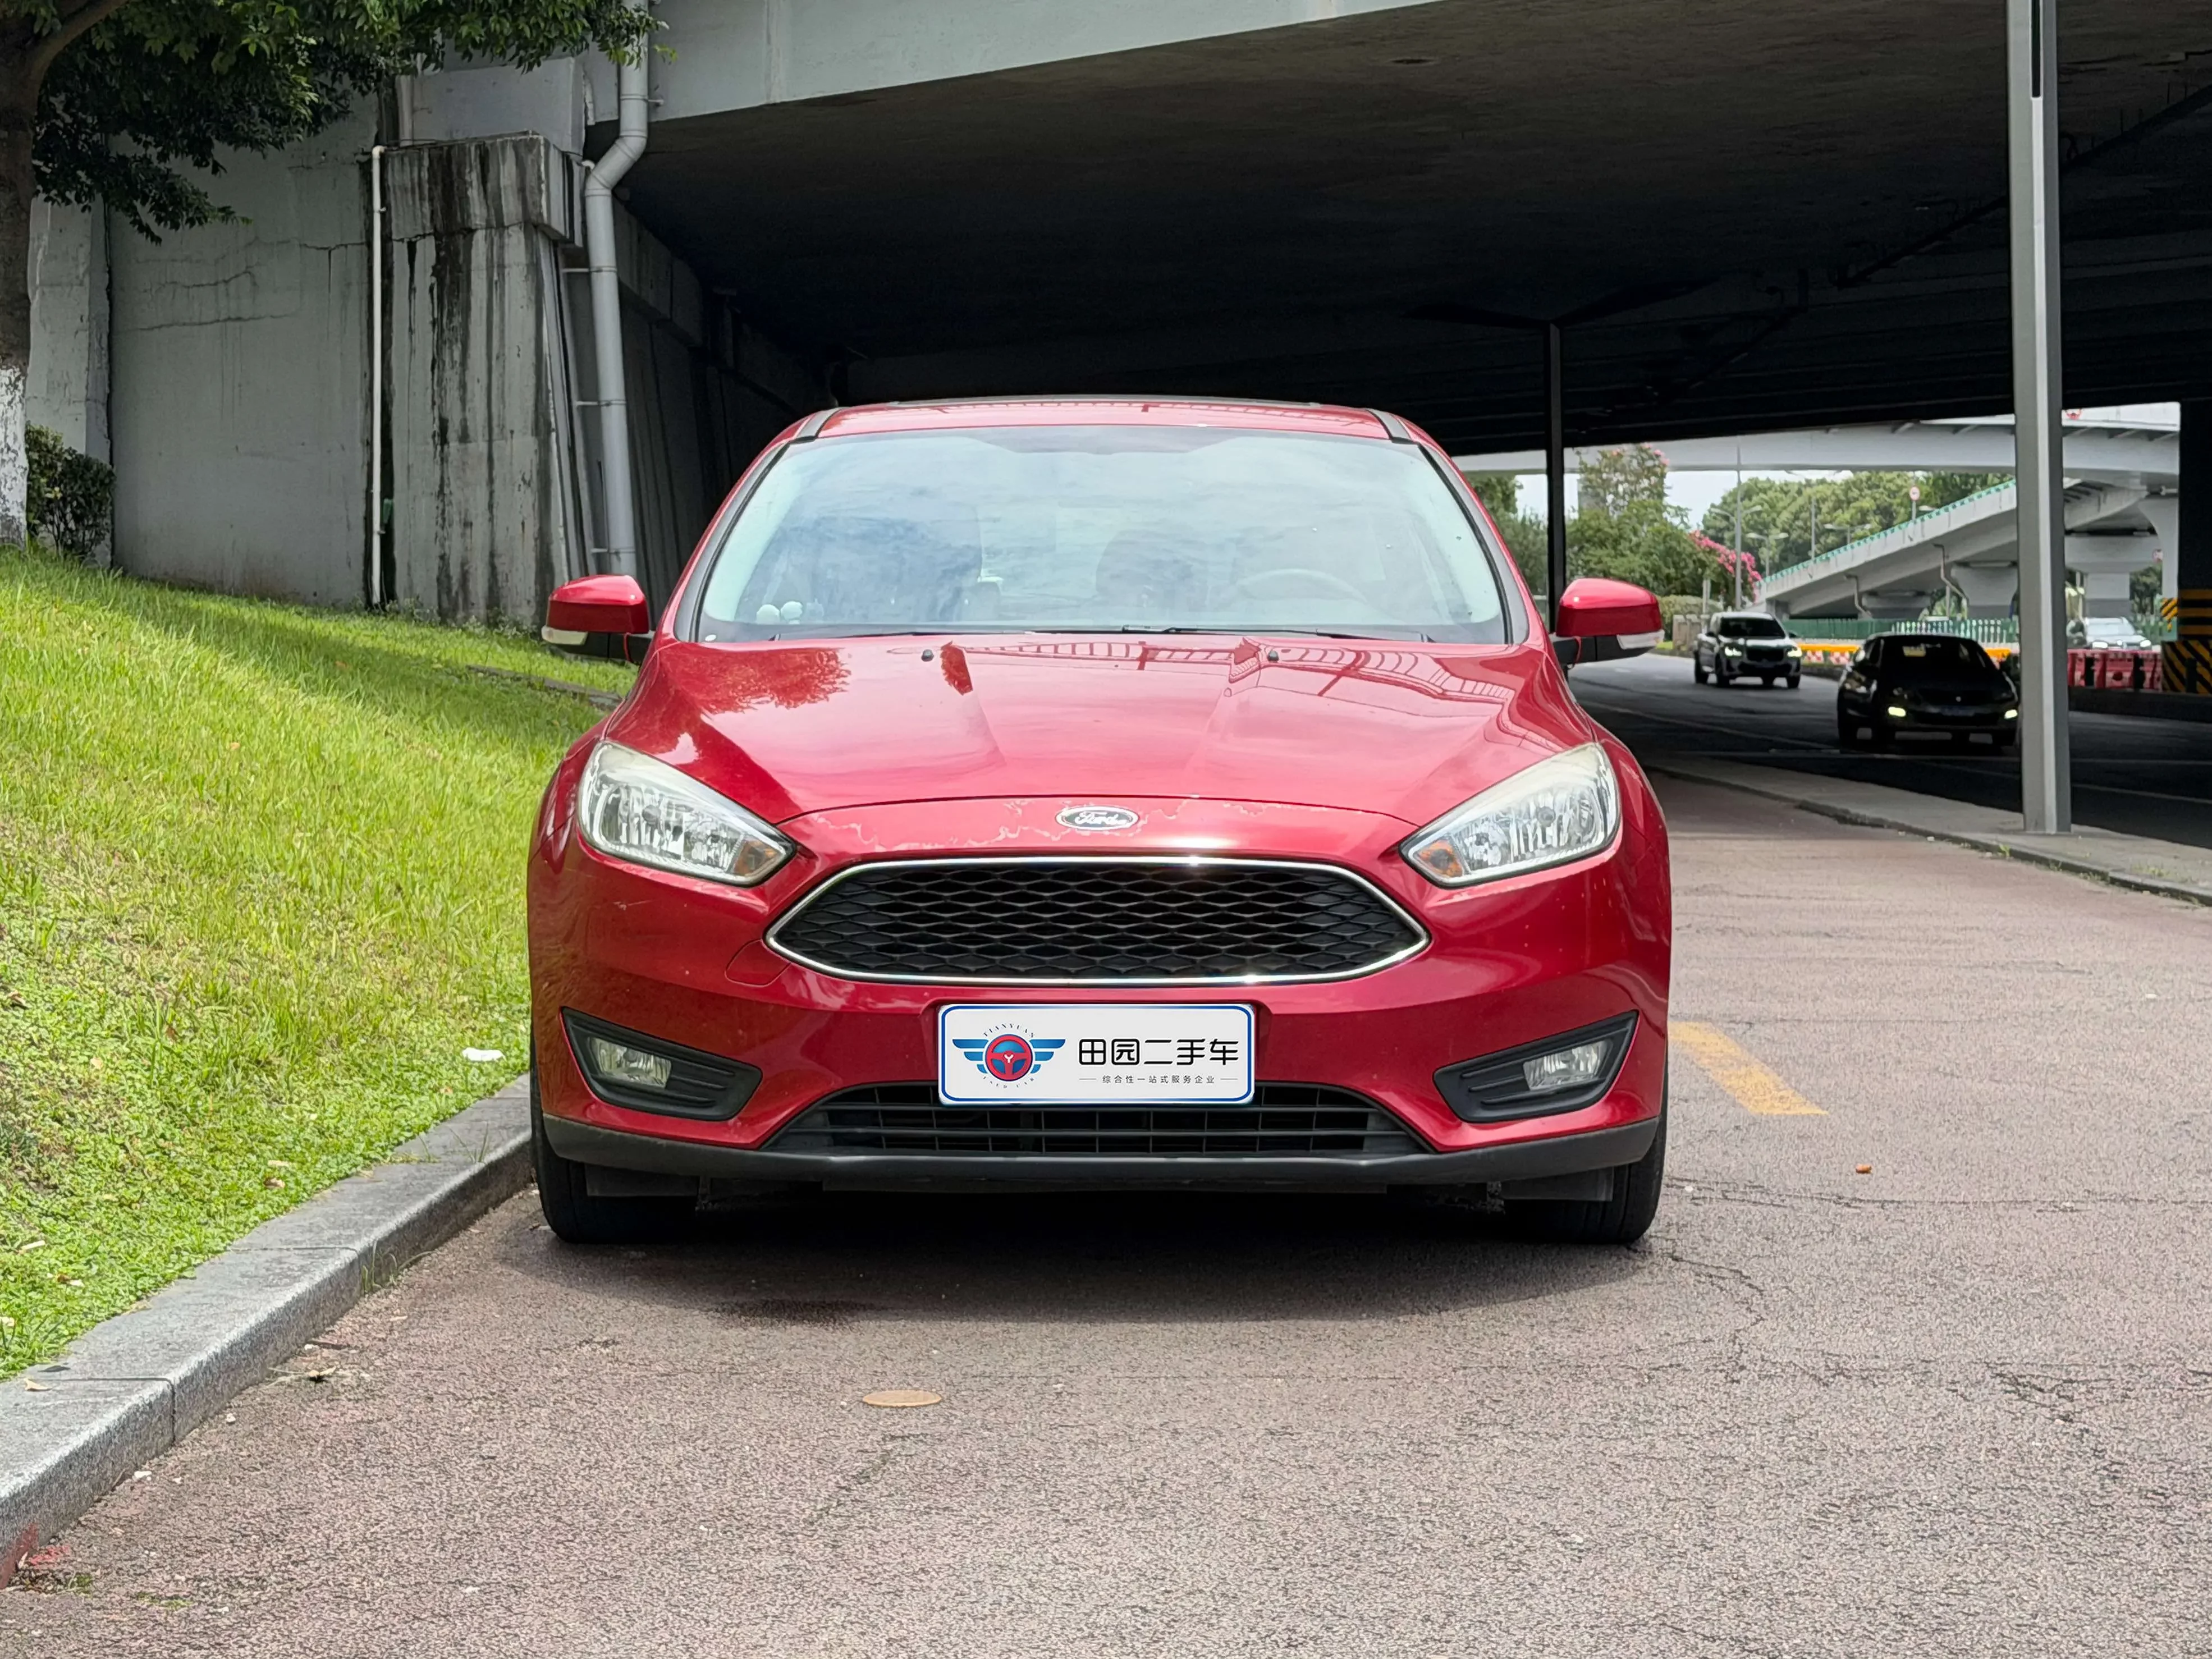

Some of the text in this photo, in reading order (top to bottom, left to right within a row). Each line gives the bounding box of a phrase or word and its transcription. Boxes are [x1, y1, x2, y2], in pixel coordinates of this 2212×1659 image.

[1074, 812, 1128, 824] Ford
[1079, 1038, 1239, 1065] 田园二手车
[1102, 1075, 1215, 1084] 综合性一站式服务企业
